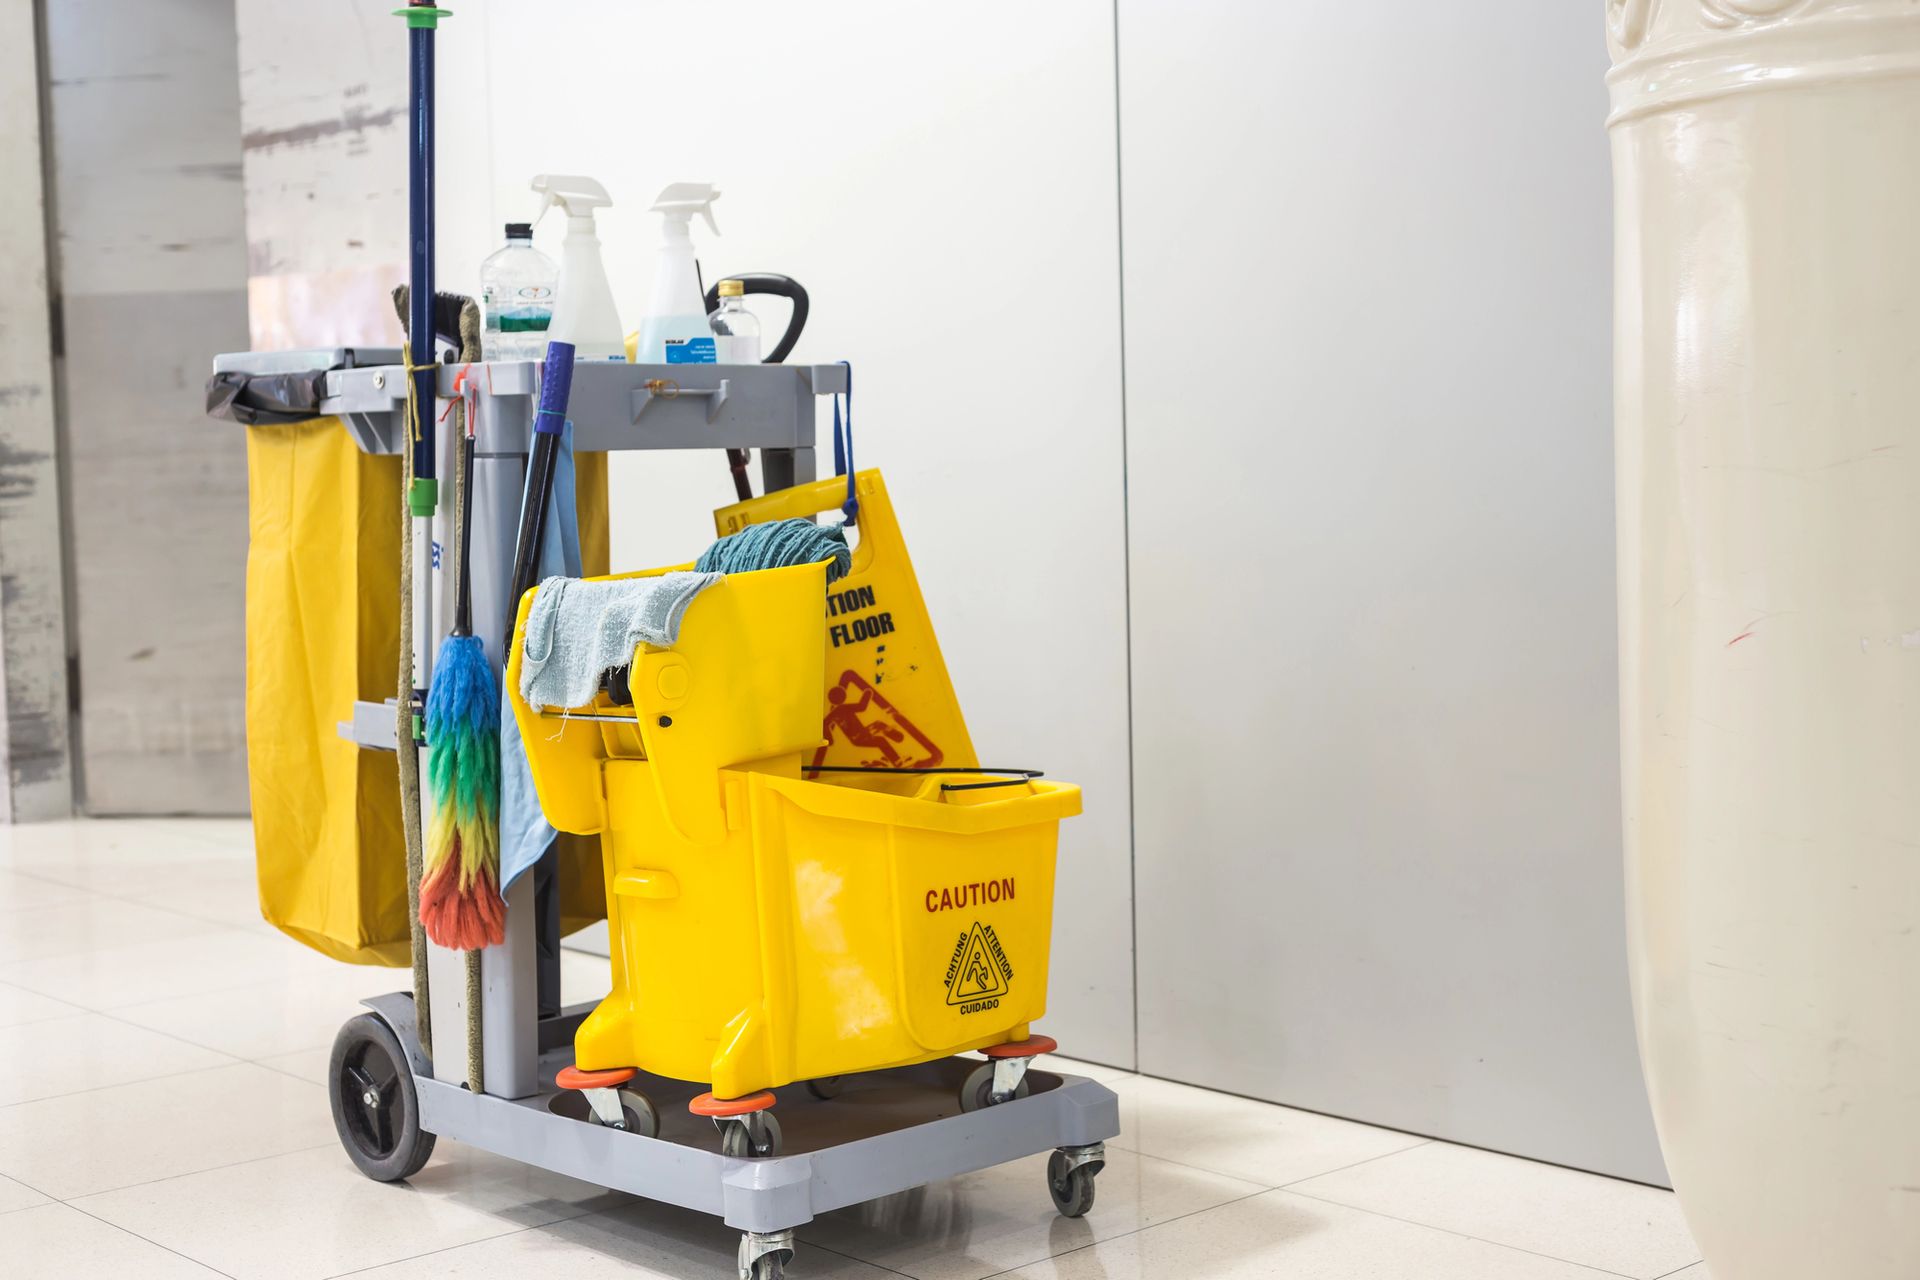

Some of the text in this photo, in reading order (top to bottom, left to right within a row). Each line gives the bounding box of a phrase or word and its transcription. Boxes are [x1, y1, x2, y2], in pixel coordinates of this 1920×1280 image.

[826, 584, 876, 617] TION
[829, 612, 895, 648] FLOOR
[925, 877, 1016, 913] CAUTION
[943, 931, 968, 988] ACHTUNG
[983, 924, 1014, 981] ATTENTION
[960, 998, 1000, 1015] CUIDADO
